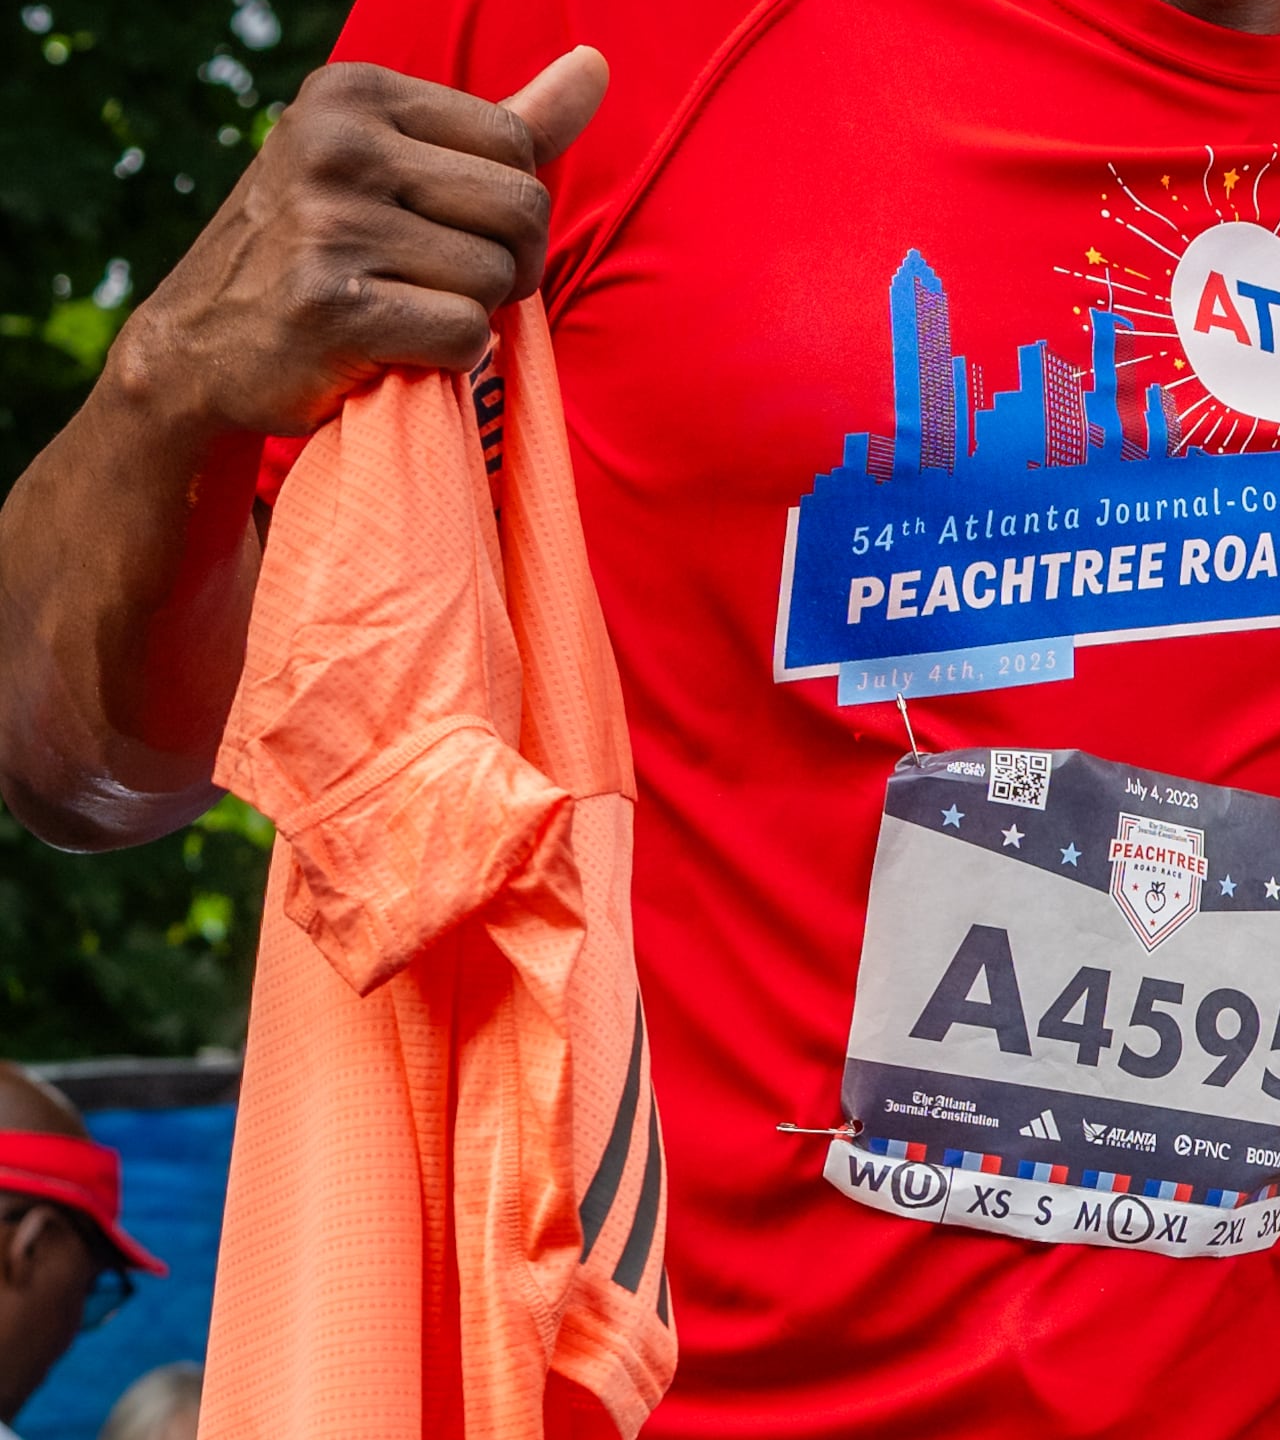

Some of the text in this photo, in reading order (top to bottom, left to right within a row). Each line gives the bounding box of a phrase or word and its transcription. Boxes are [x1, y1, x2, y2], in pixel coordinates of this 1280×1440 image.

[852, 517, 926, 555] 54th
[939, 506, 1080, 544] Atlanta
[847, 543, 1164, 625] PEACHTREE
[857, 651, 1057, 691] July 4th, 2023
[1125, 777, 1199, 809] July 4, 2023
[1112, 843, 1206, 876] PEACHTREE
[1134, 864, 1182, 879] ROAD RACE
[885, 1098, 1000, 1128] Journal-Constitution
[912, 1090, 977, 1112] The Atlanta
[1107, 1127, 1157, 1146] ATLANTA
[1194, 1139, 1231, 1160] PNC
[849, 1155, 891, 1192] W
[904, 1170, 932, 1201] U
[966, 1185, 1012, 1218] XS
[1034, 1195, 1053, 1226] S
[1073, 1201, 1101, 1232] M
[1120, 1208, 1133, 1235] L
[1155, 1213, 1188, 1242] XL
[1207, 1218, 1246, 1246] 2XL
